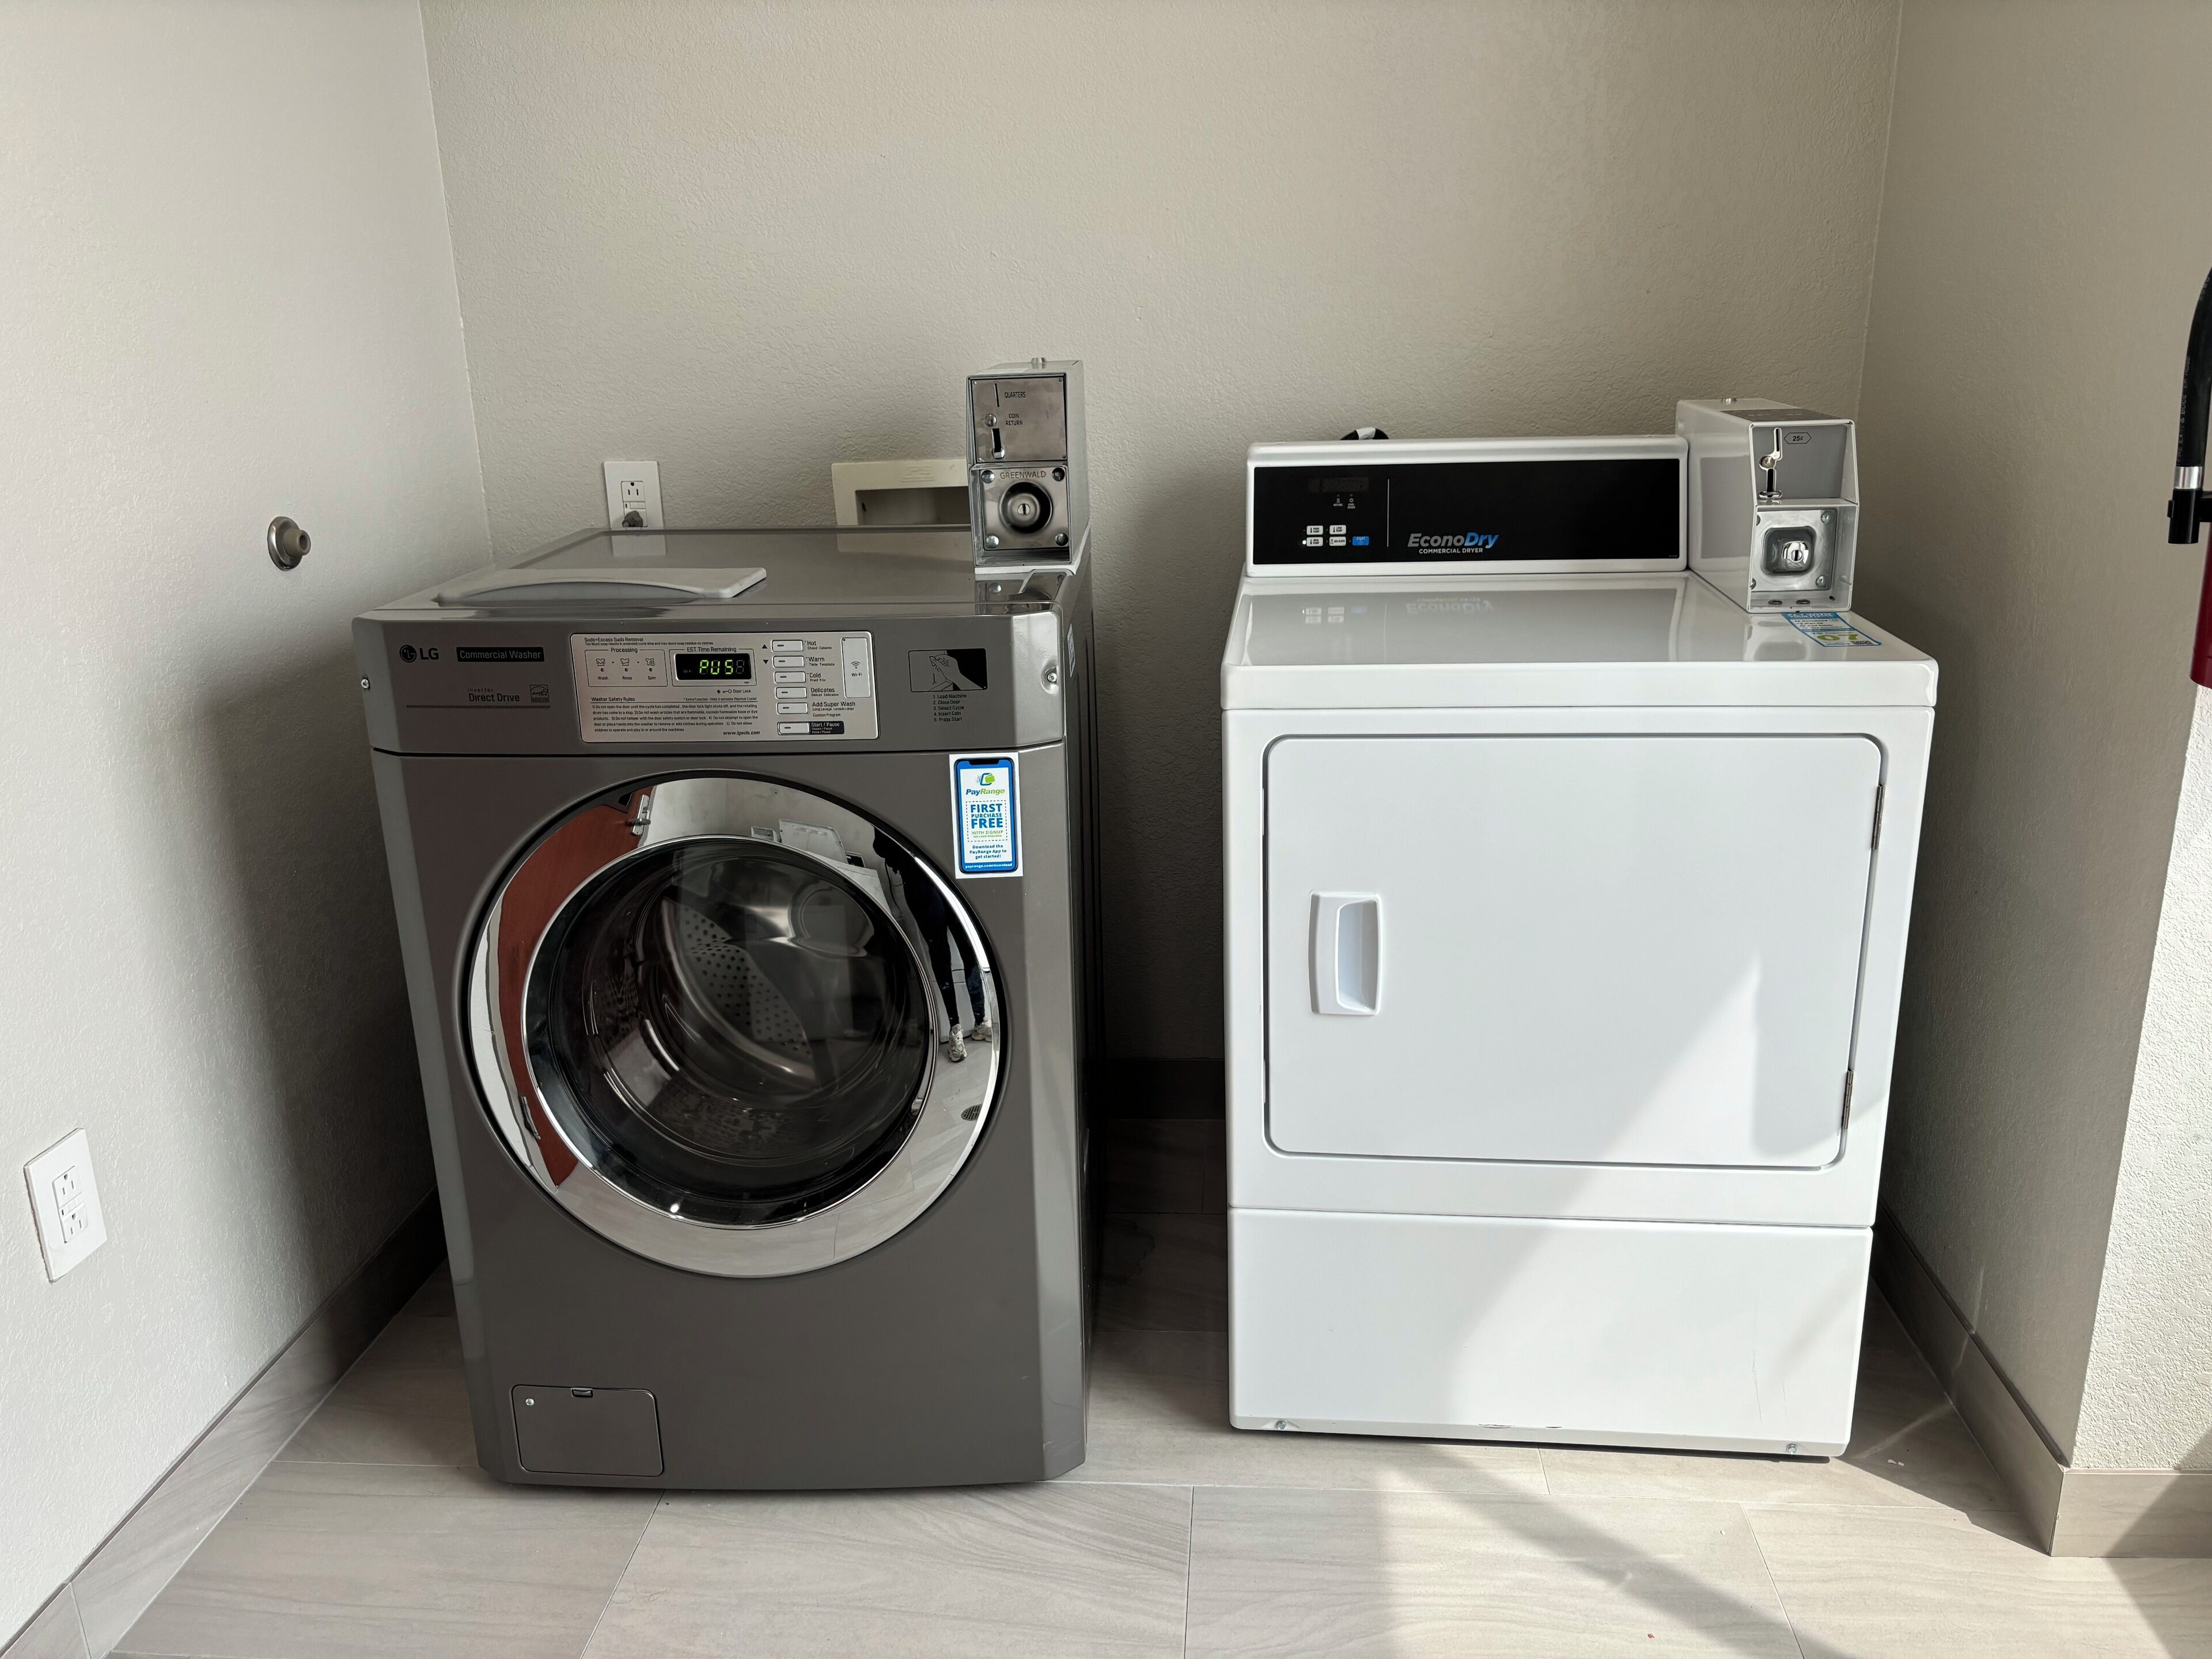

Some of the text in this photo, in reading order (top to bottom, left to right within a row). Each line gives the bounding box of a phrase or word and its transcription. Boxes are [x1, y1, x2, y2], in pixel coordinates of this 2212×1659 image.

[1000, 471, 1046, 479] GREENWALD
[1407, 532, 1499, 549] EconoDry
[419, 647, 541, 660] LG Commercial Washer
[469, 693, 520, 702] Direct Drive
[970, 804, 1002, 813] FIRST
[971, 818, 1003, 829] FREE
